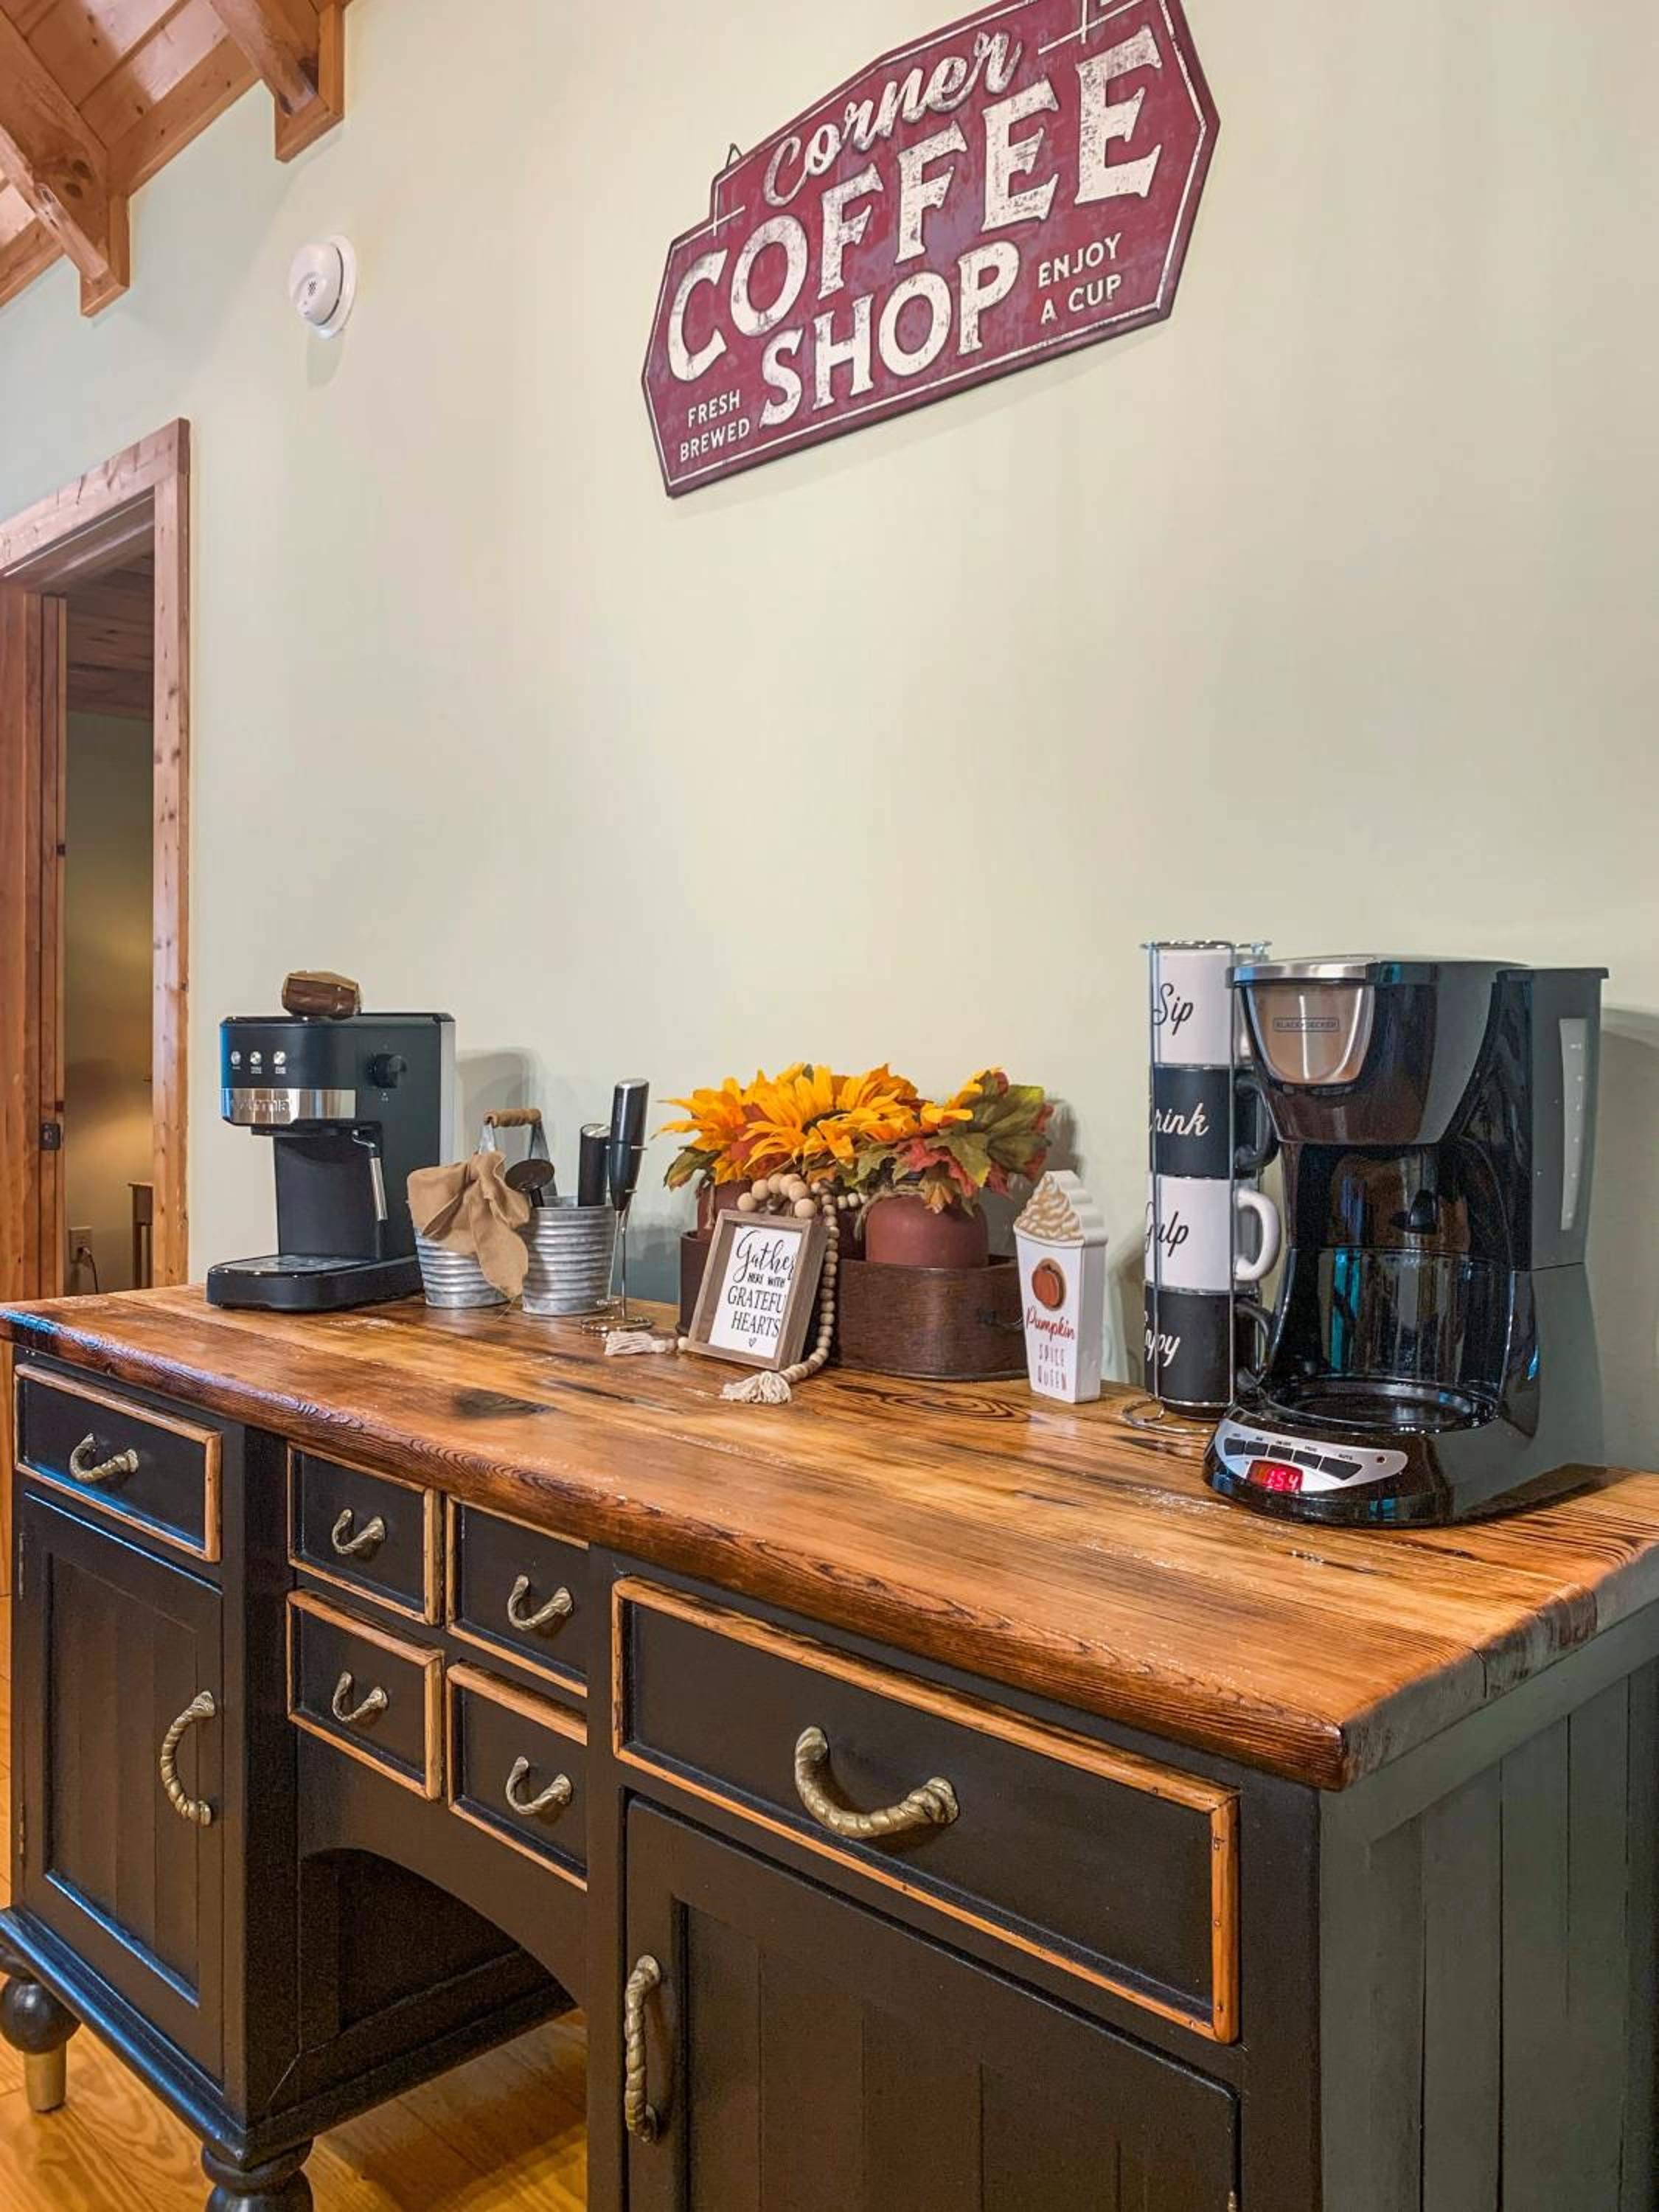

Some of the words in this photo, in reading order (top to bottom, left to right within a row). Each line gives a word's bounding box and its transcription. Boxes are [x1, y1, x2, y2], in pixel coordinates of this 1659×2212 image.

[763, 30, 1022, 206] Corner
[667, 24, 1164, 383] COFFEE
[1037, 233, 1121, 288] ENJOY
[1040, 304, 1058, 326] A
[1068, 274, 1122, 313] CUP
[759, 240, 1020, 429] SHOP
[687, 389, 740, 427] FRESH
[679, 417, 750, 462] BREWED
[1151, 983, 1194, 1036] Sip
[1147, 1102, 1209, 1136] rink
[728, 1285, 786, 1313] GRATEFU
[768, 1276, 786, 1288] WITH
[731, 1310, 781, 1338] HEARTS
[1026, 1306, 1074, 1341] Pumpkin
